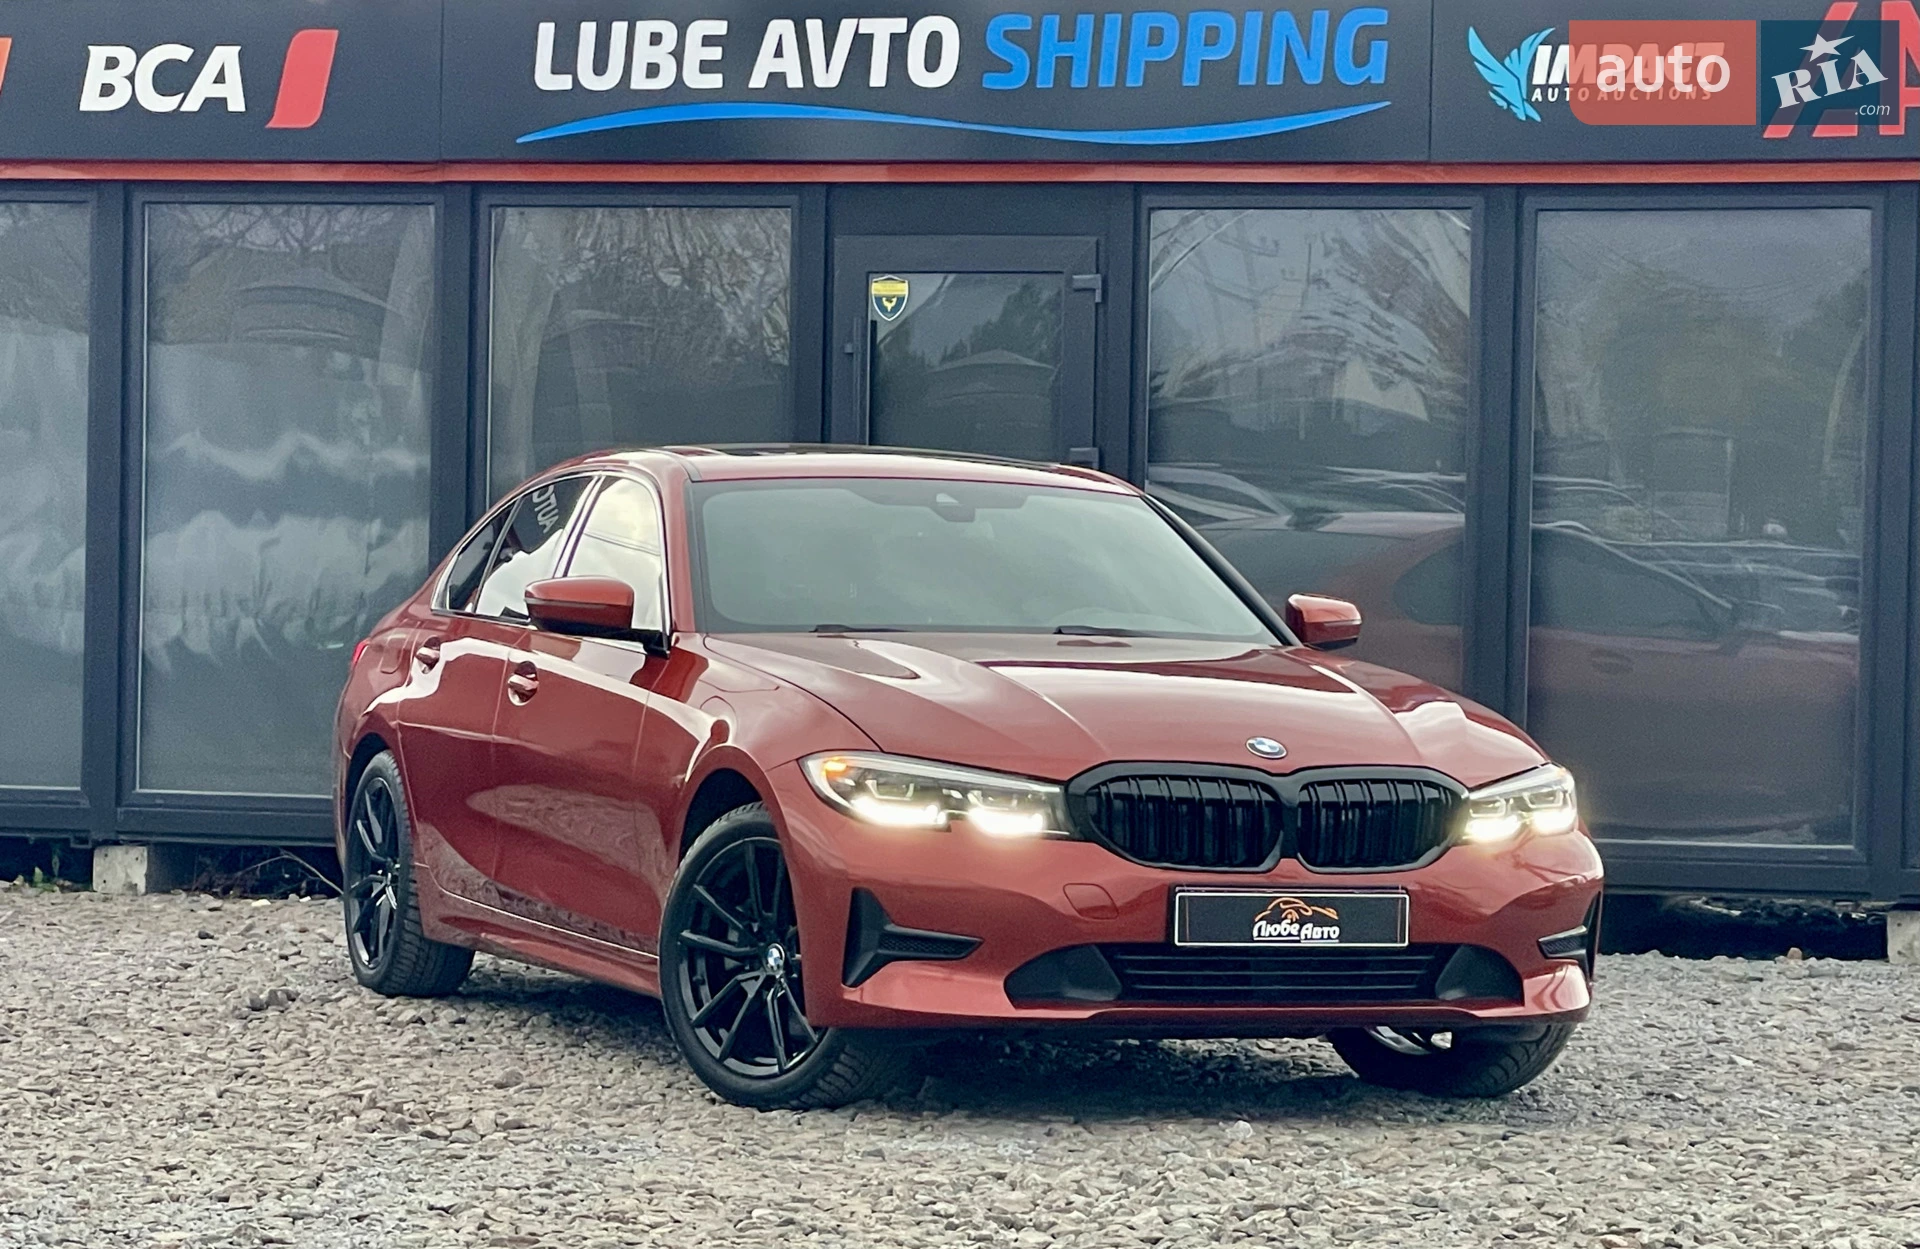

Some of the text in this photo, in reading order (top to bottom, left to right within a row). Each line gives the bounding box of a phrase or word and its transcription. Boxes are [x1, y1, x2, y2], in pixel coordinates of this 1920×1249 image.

[79, 43, 247, 113] BCA
[534, 8, 1390, 91] LUBE AVTO SHIPPING
[1531, 87, 1590, 102] AUTO
